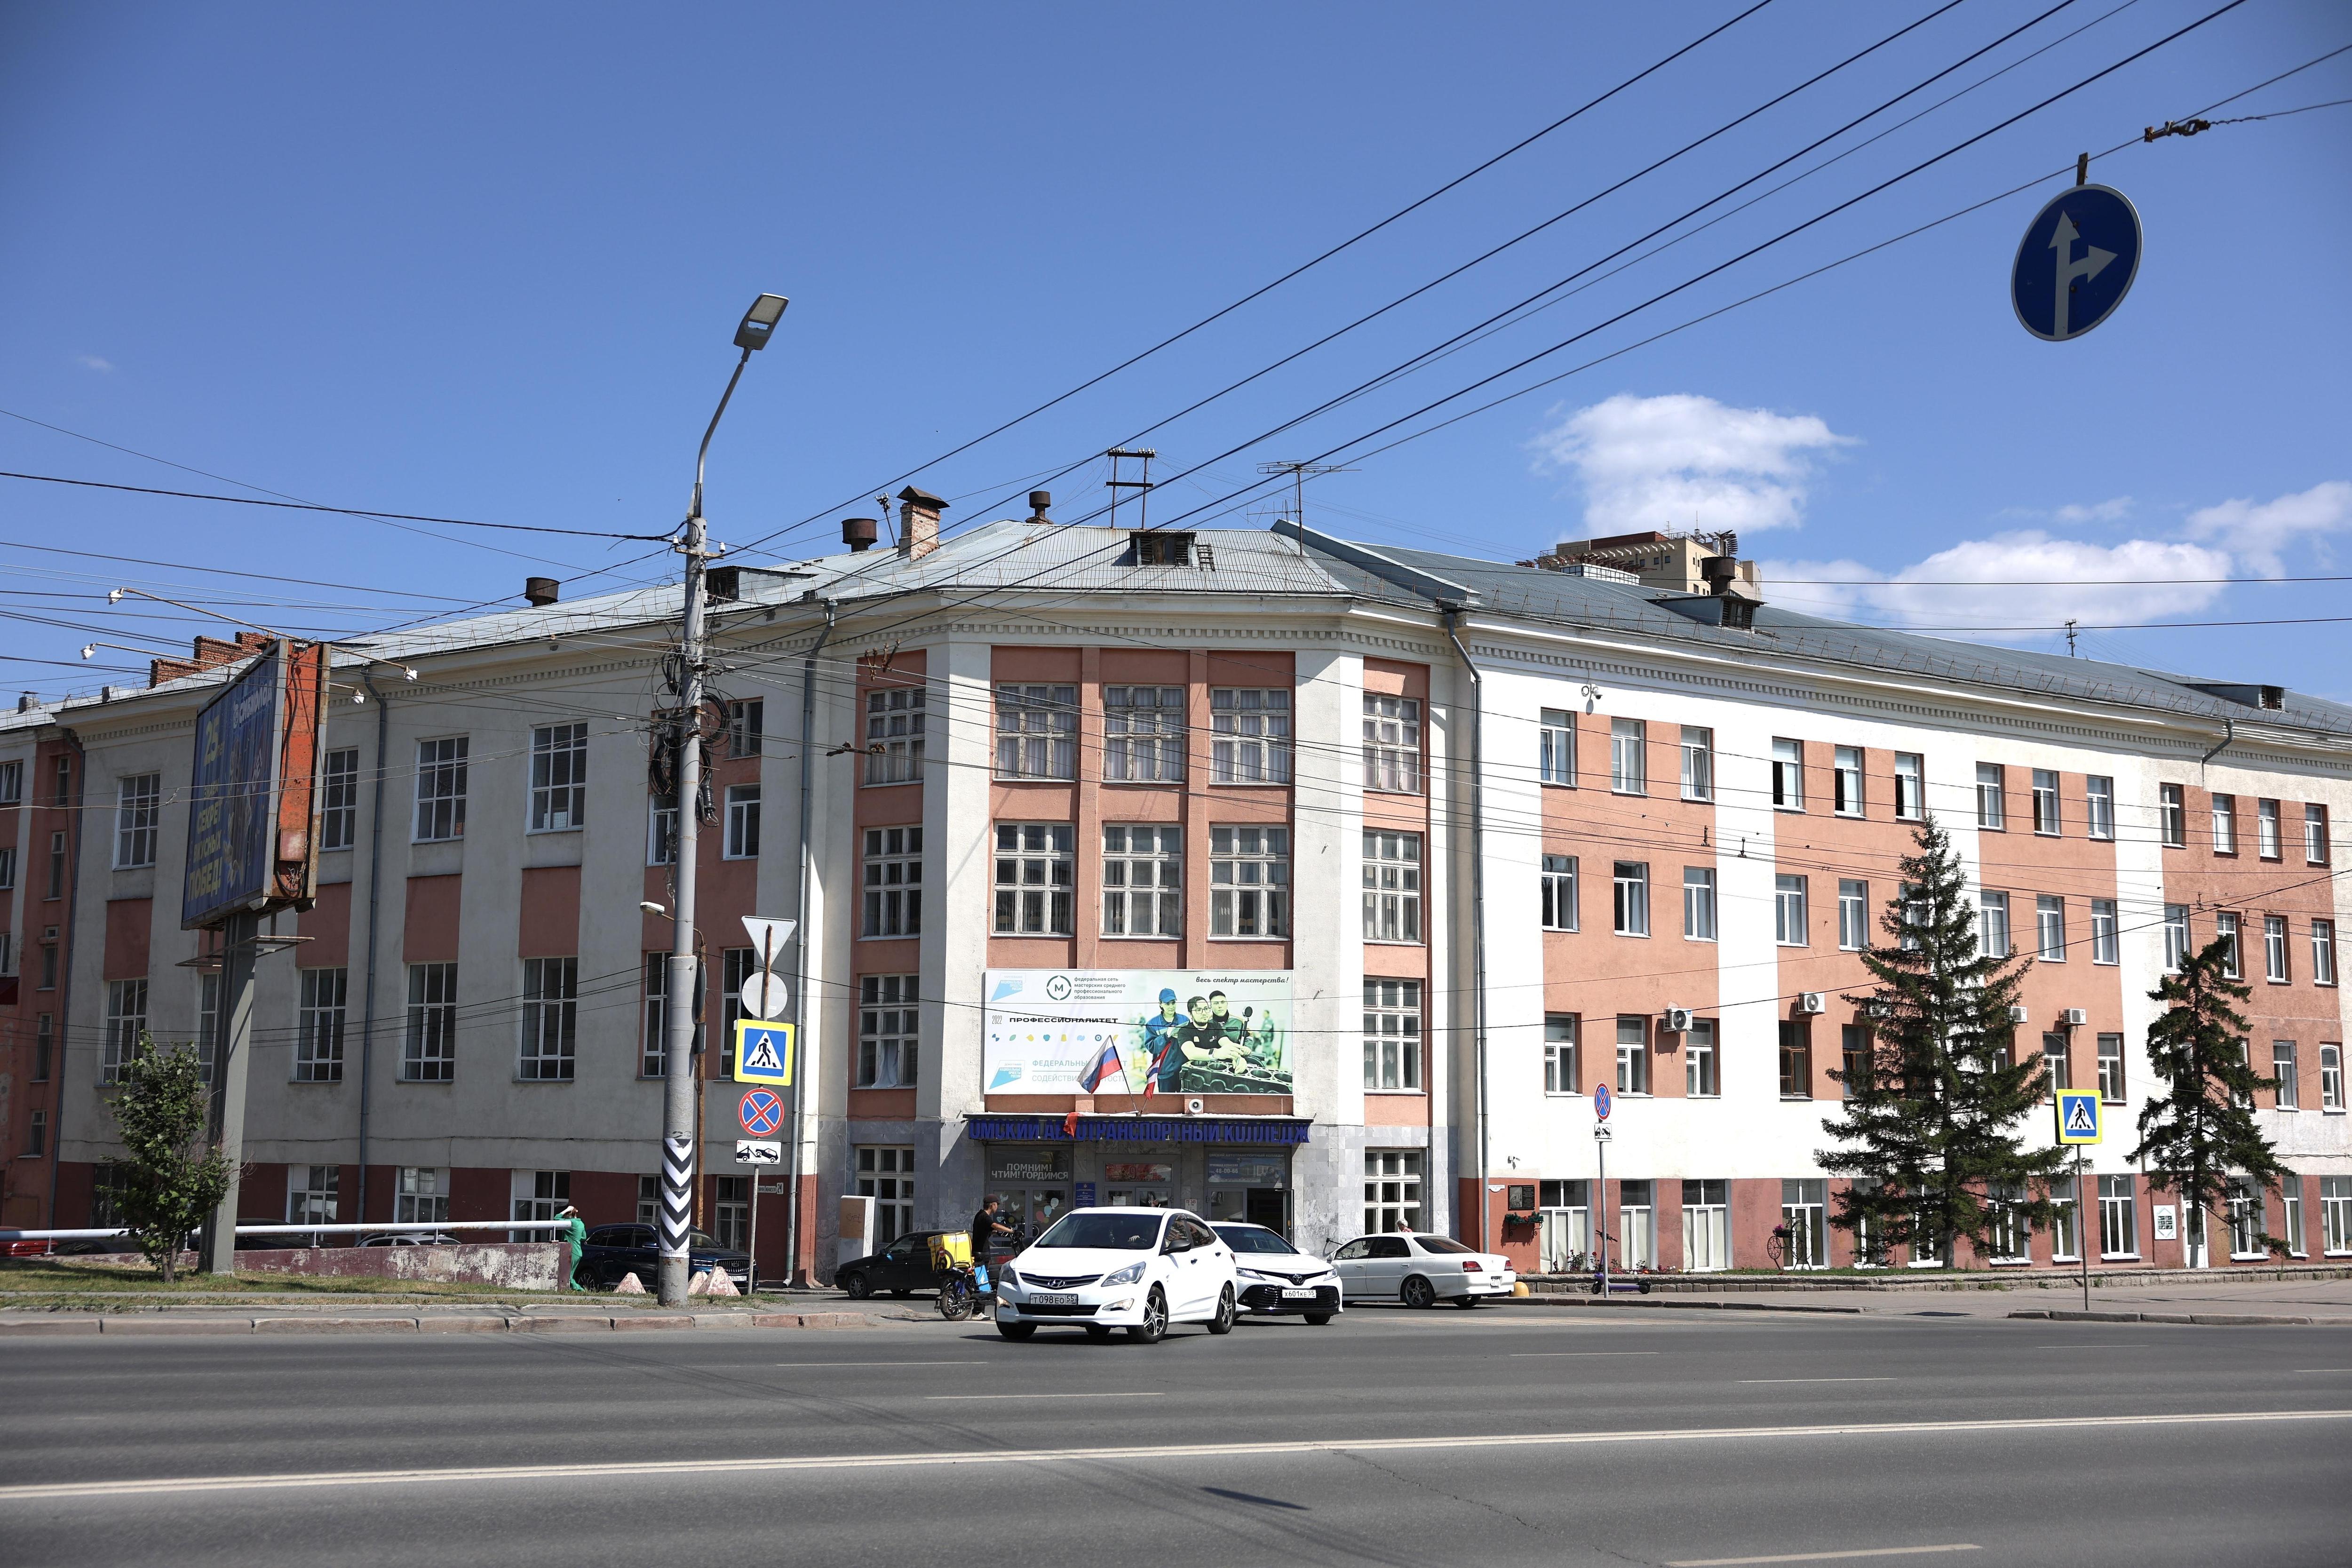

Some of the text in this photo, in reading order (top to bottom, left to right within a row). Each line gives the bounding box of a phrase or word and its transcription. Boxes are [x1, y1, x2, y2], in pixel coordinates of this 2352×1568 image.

[203, 715, 220, 767] 25
[198, 799, 223, 835] СЕКРЕТ
[193, 829, 222, 863] ВКУСНЫХ
[188, 856, 222, 902] ПОБЕД!
[1213, 977, 1239, 985] спектр
[1240, 977, 1289, 985] мастерства!
[992, 1015, 1002, 1025] 2022
[1032, 1074, 1078, 1083] СОДЕЙСТВИ
[969, 1117, 1311, 1143] ОМСКИЙ АВОТРАНСПОРТНЫЙ КОЛЛЕДЖ
[1022, 1171, 1068, 1181] ГОРДИМСЯ
[777, 1184, 782, 1193] 24
[1033, 1295, 1065, 1304] Т098ЕО
